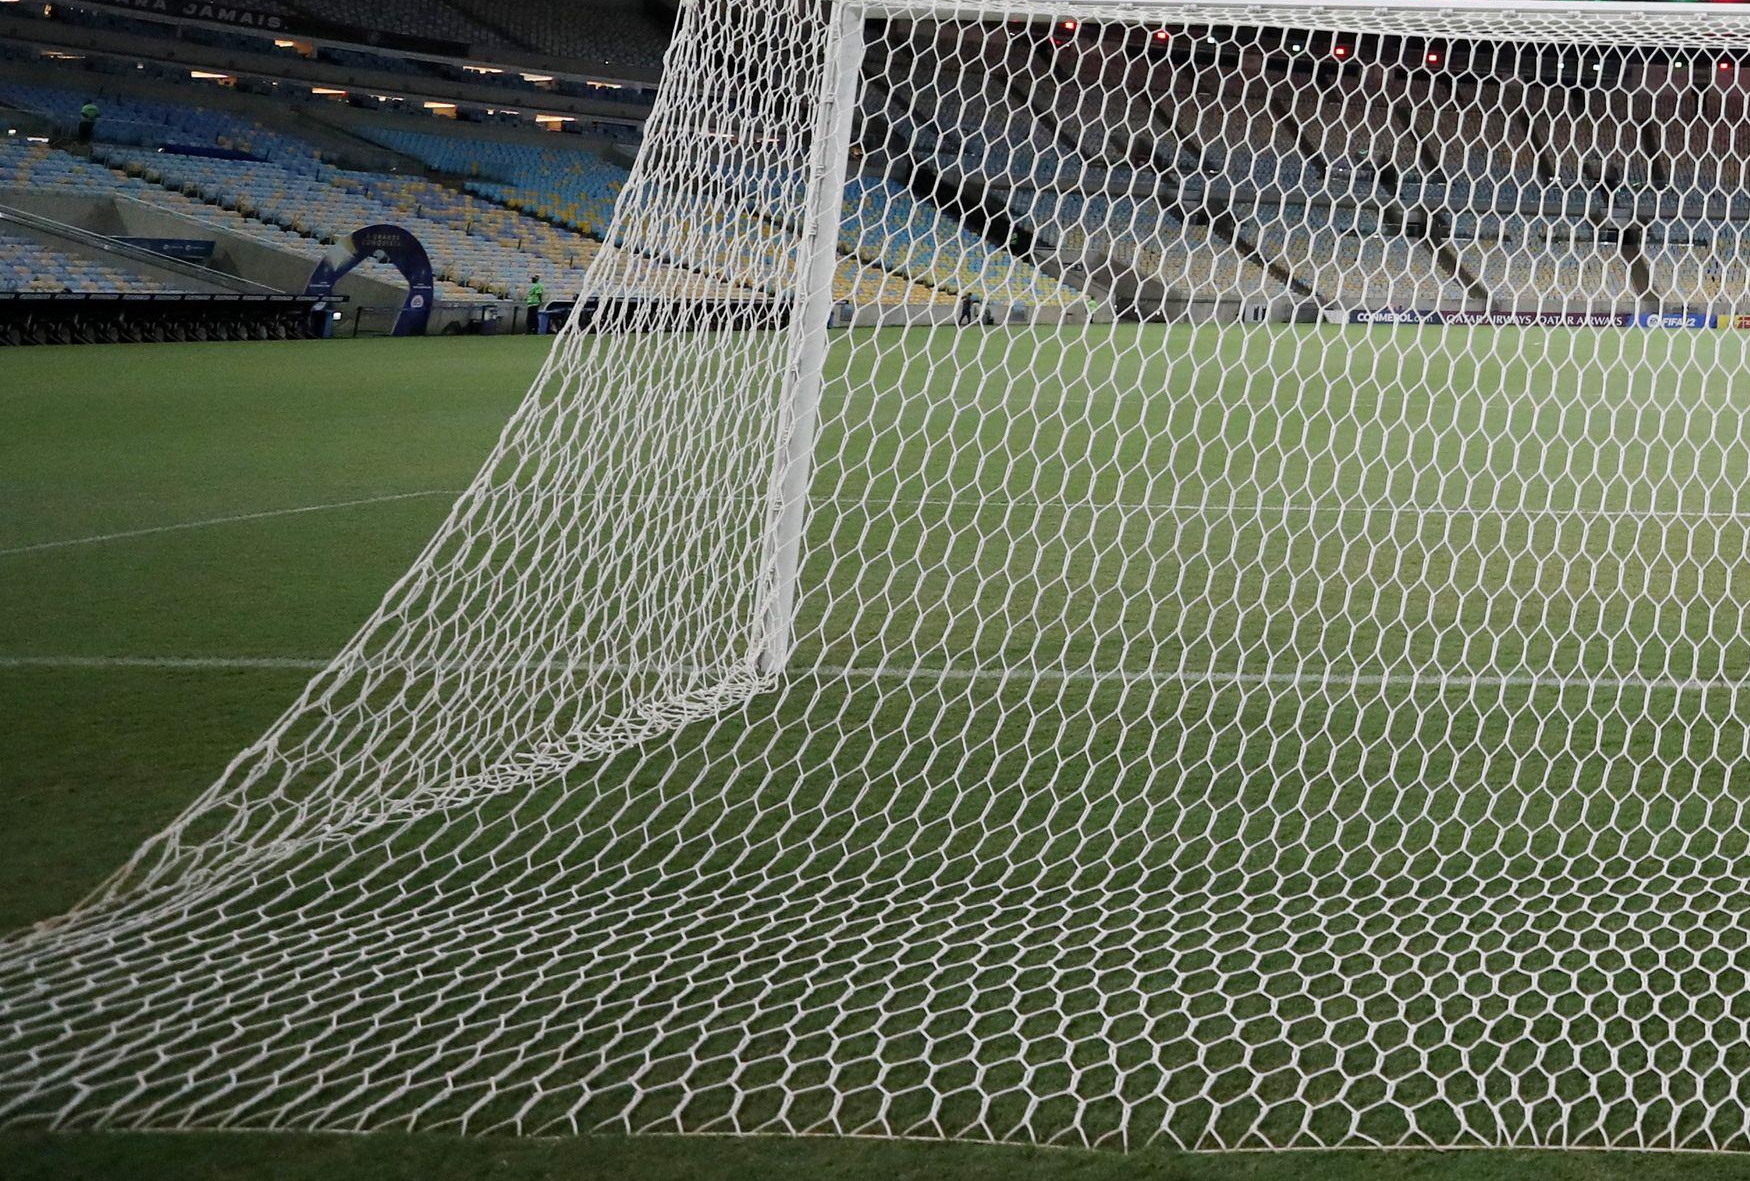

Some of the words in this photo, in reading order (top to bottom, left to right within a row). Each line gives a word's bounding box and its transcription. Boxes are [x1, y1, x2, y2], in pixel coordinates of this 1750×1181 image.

[182, 4, 289, 30] JAMAIS.
[1539, 316, 1574, 325] QATR
[1576, 316, 1623, 326] ARWAS
